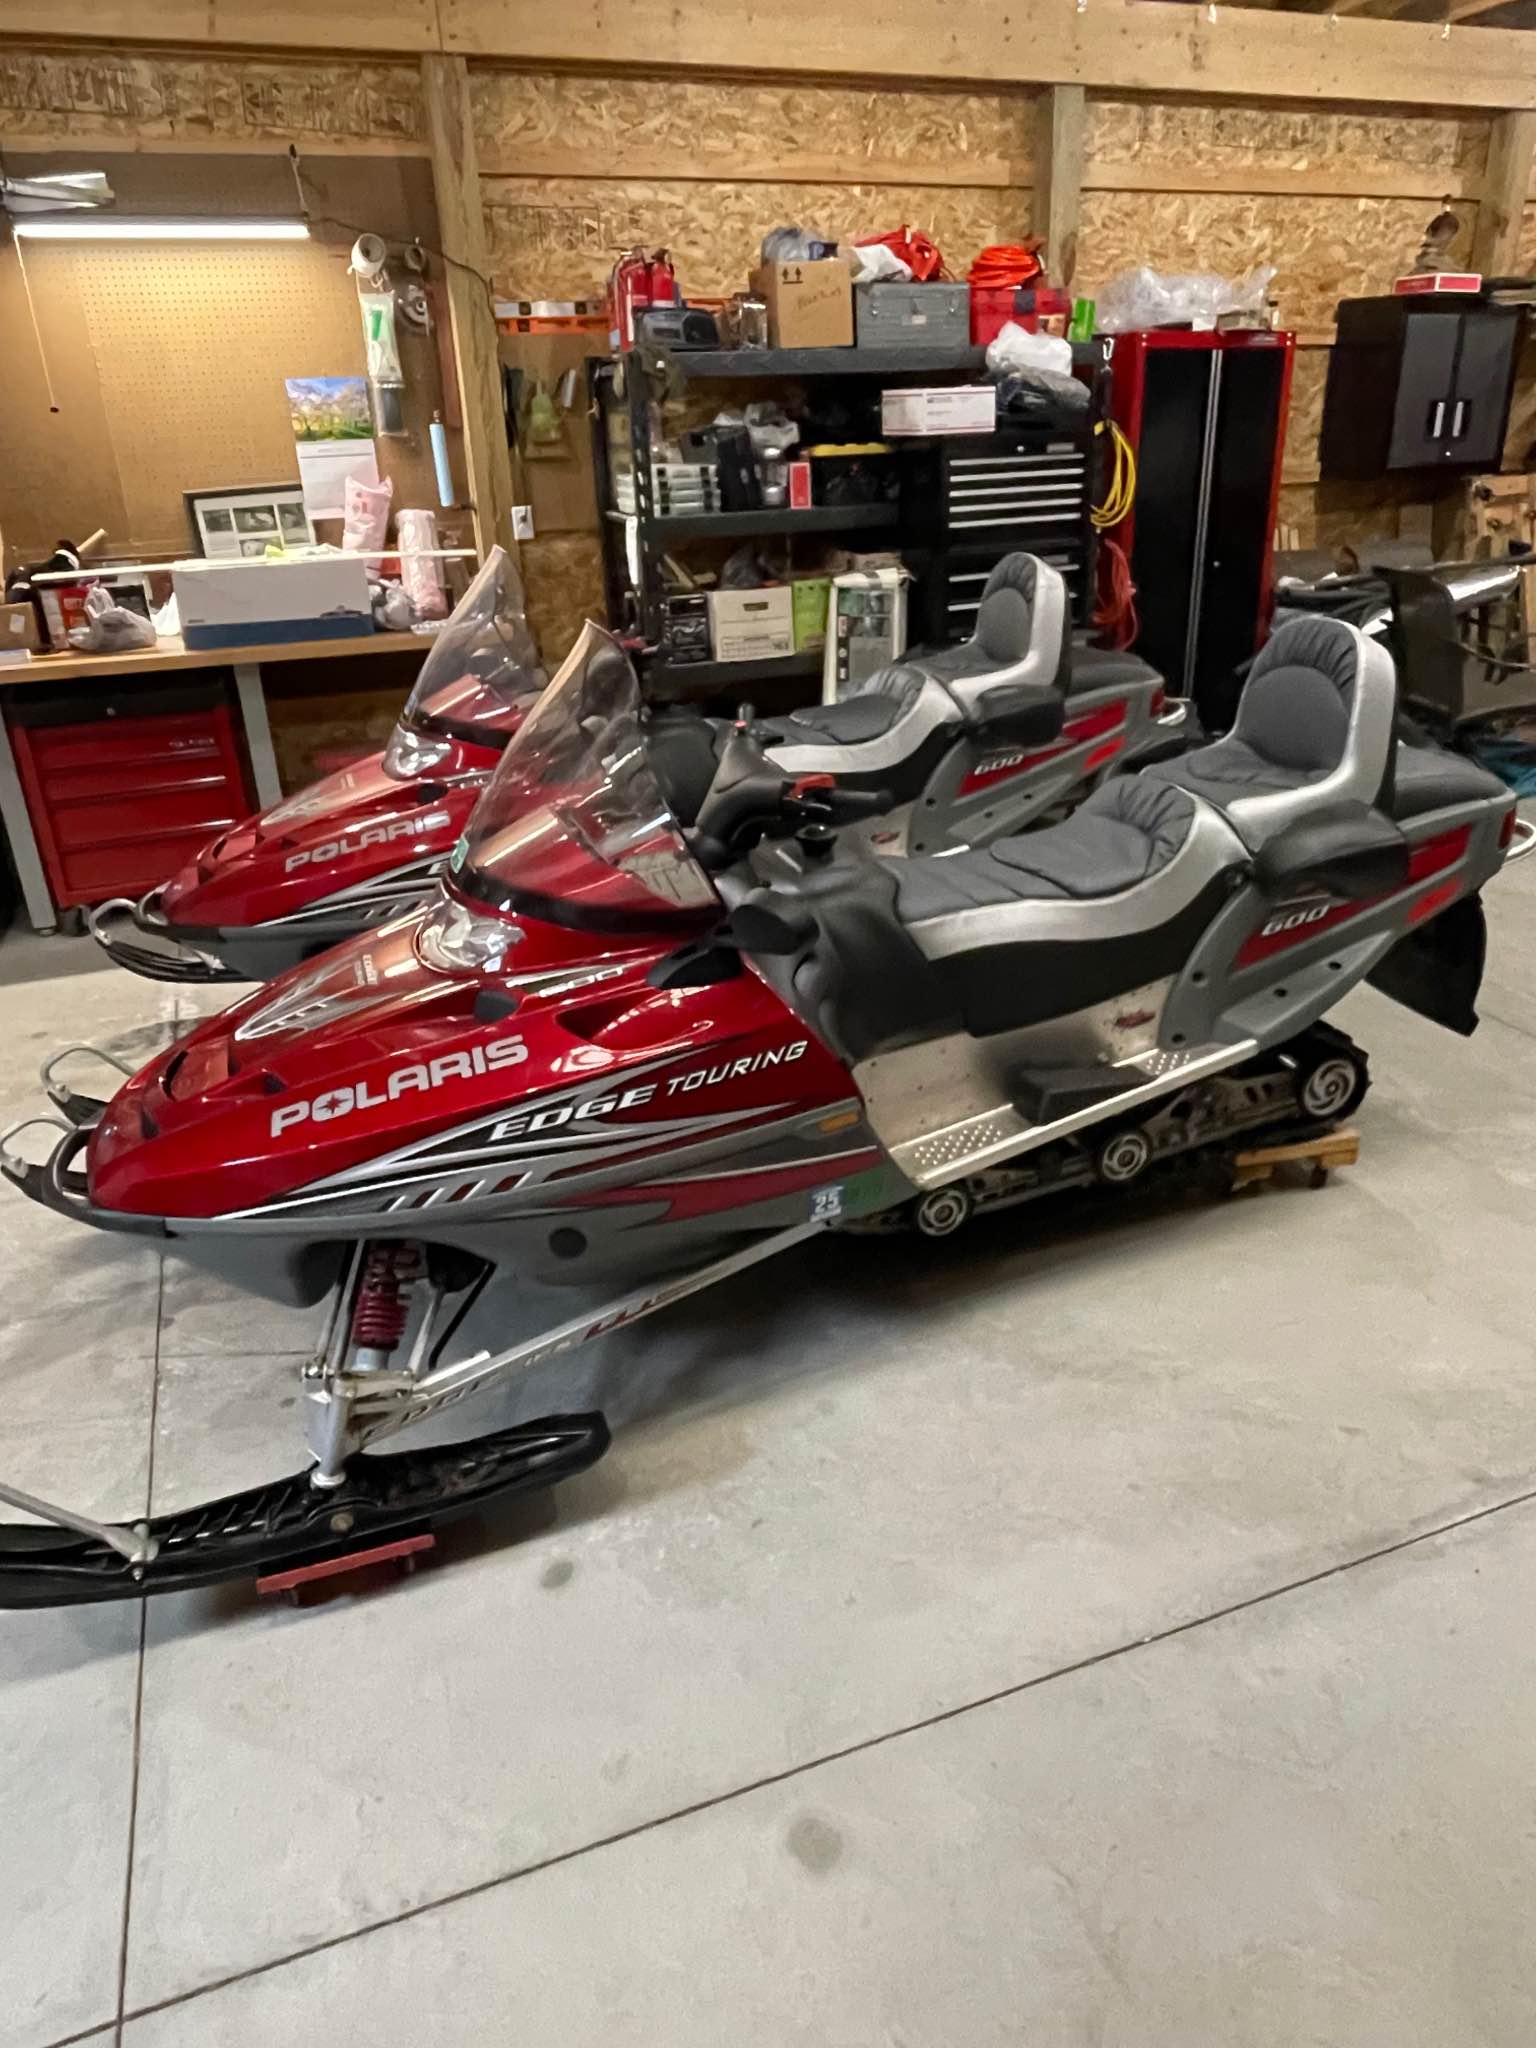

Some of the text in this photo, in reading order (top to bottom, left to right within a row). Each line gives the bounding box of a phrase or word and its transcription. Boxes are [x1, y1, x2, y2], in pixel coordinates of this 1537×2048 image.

[973, 753, 1025, 776] 600
[283, 810, 452, 874] POLARIS
[1261, 903, 1331, 937] 600
[270, 1034, 529, 1139] POLARIS
[486, 1040, 809, 1142] EDGE TOURING
